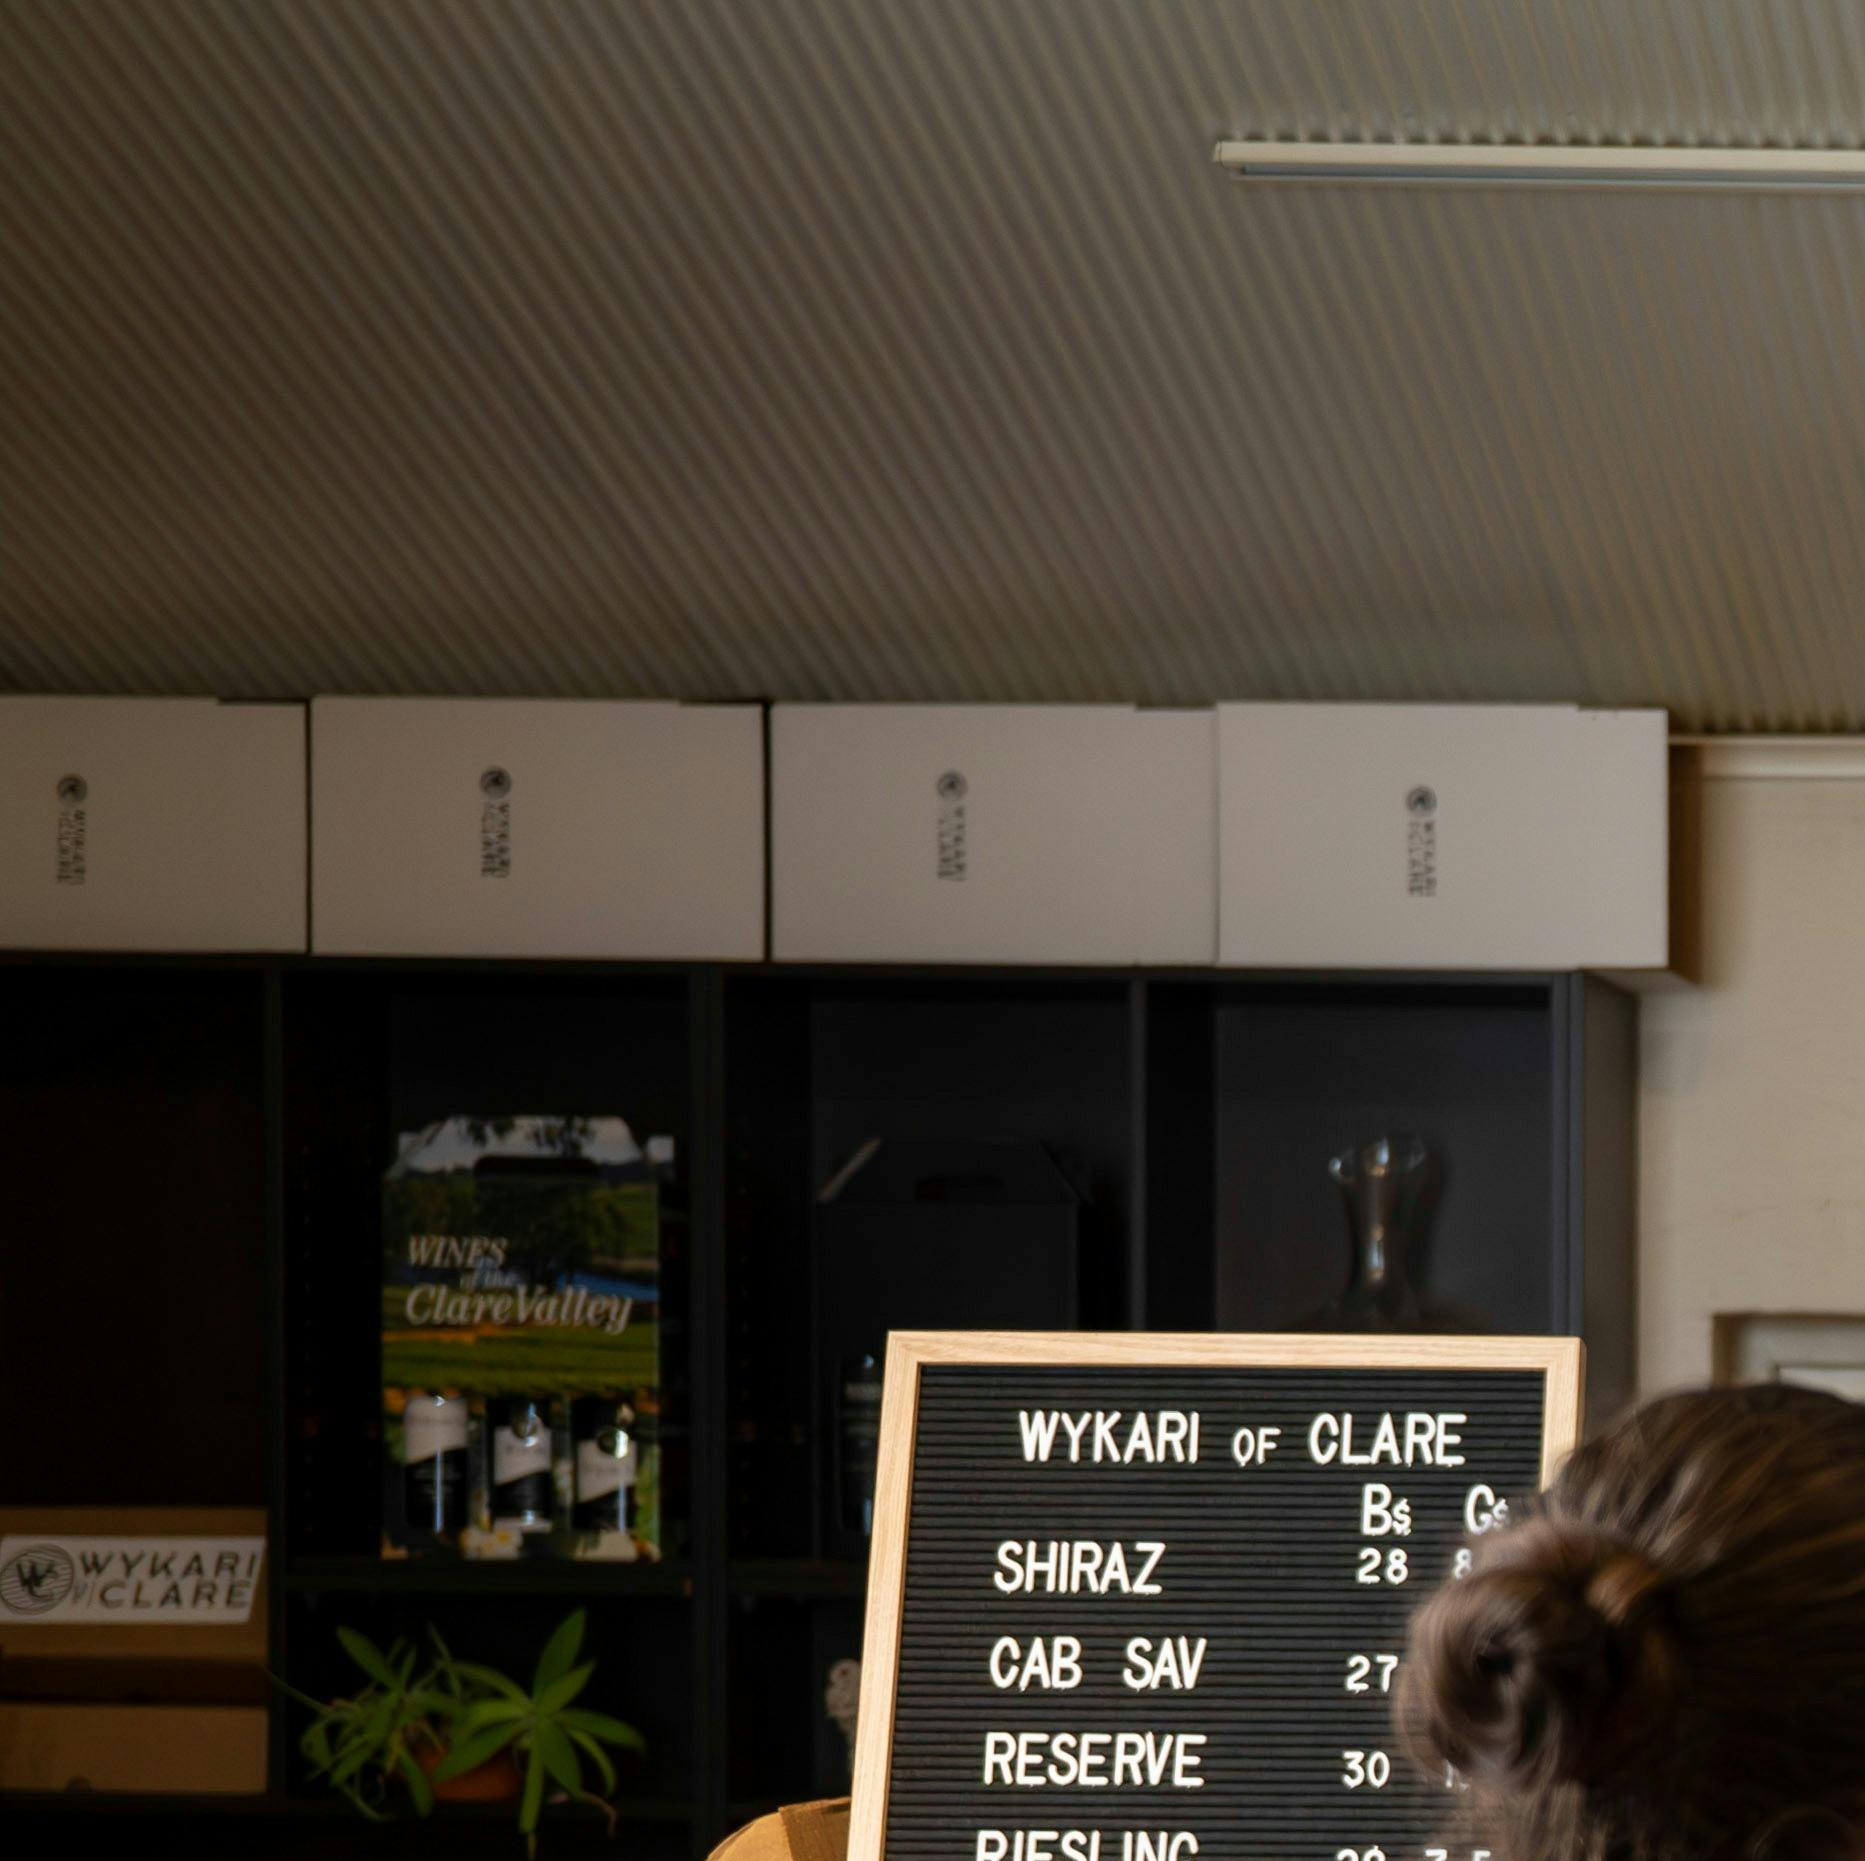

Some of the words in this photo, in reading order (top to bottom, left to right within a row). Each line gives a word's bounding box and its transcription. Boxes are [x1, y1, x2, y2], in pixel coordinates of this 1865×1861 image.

[409, 1235, 508, 1268] WINES
[1018, 1410, 1200, 1465] WYKARI
[1232, 1427, 1281, 1467] OF
[1309, 1412, 1469, 1467] CLARE
[1361, 1483, 1412, 1537] B$
[80, 1551, 258, 1577] WYKARI
[993, 1541, 1166, 1595] SHIRAZ
[1356, 1548, 1409, 1585] 28
[99, 1580, 252, 1609] CLARE
[988, 1636, 1084, 1690] CAB
[1122, 1636, 1208, 1691] SAV
[1345, 1655, 1399, 1694] 27
[983, 1731, 1208, 1789] RESERVE
[1342, 1750, 1391, 1789] 30
